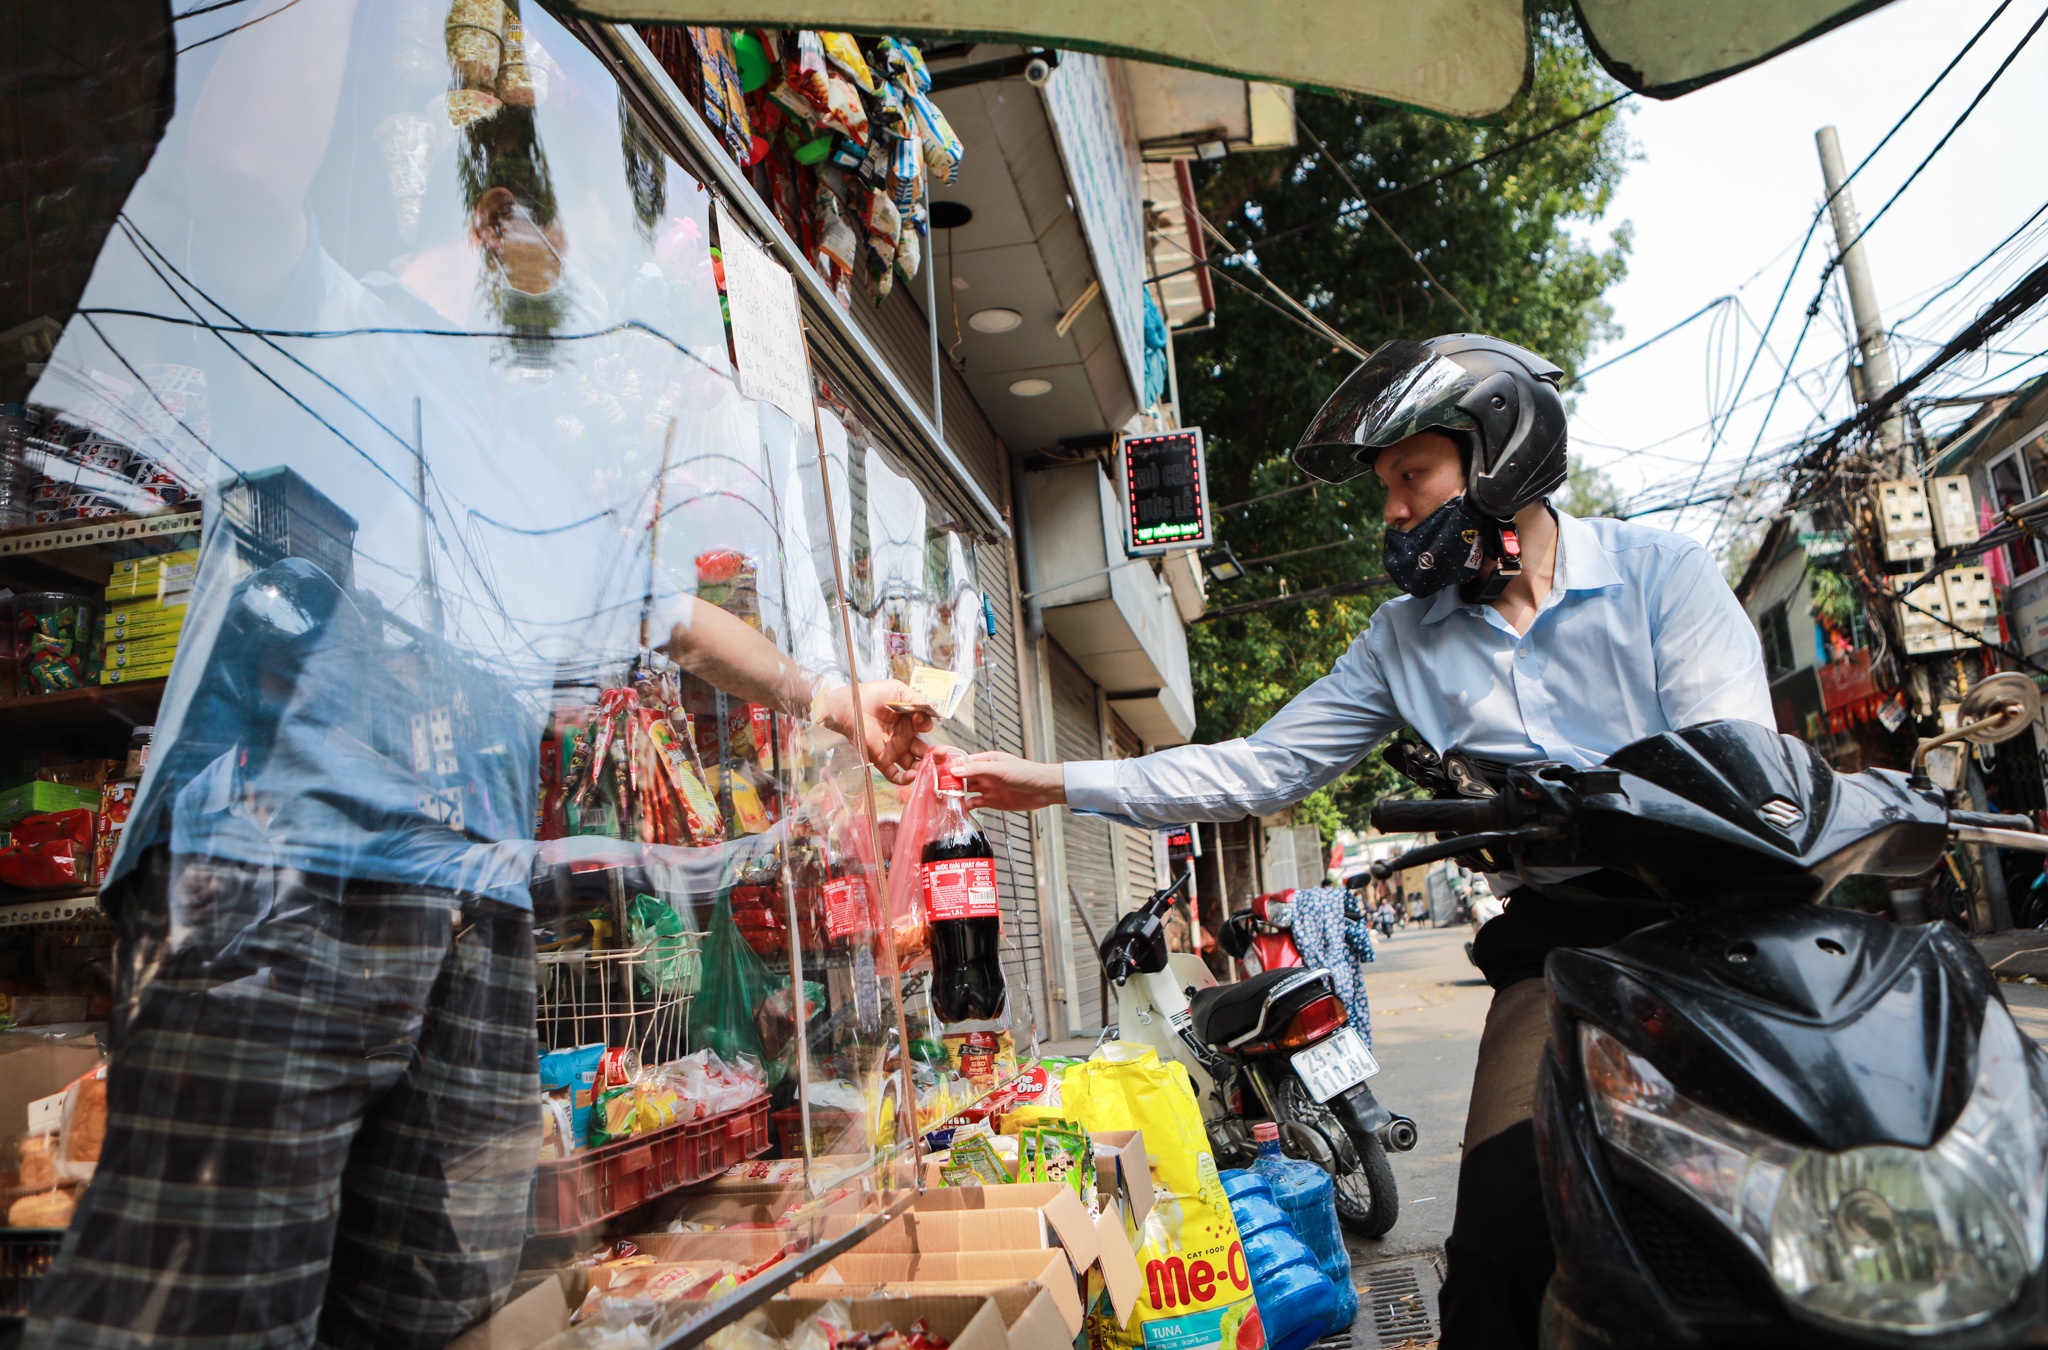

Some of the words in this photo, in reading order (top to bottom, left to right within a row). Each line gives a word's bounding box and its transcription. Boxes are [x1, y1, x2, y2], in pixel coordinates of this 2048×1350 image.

[1017, 1082, 1044, 1093] One
[1187, 1251, 1203, 1260] CAT
[1205, 1245, 1225, 1256] FOOD
[1152, 1324, 1183, 1339] TUNA
